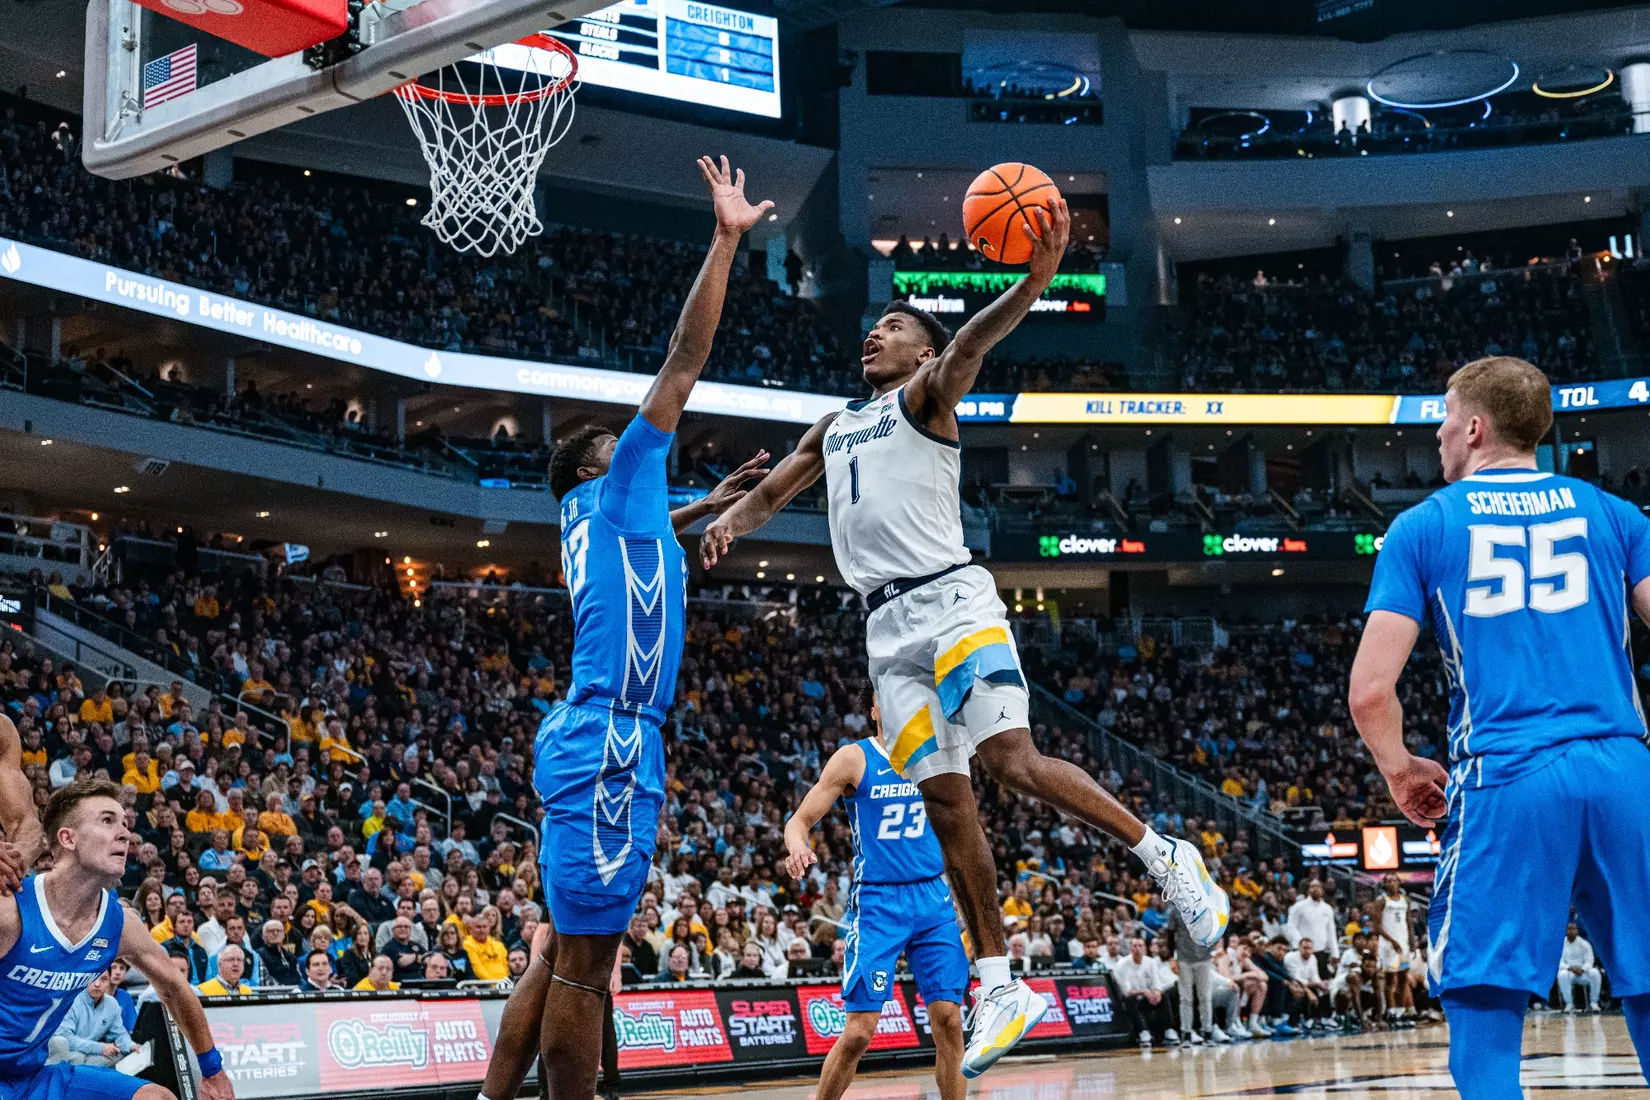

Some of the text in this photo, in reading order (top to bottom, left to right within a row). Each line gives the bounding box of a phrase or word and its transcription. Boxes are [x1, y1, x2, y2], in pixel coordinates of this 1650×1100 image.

[687, 5, 754, 31] CREIGHTON
[721, 68, 729, 82] 1
[105, 270, 363, 355] Pursuing Better Healthcare
[1559, 386, 1599, 407] TOL
[979, 401, 1004, 416] PM
[1086, 400, 1223, 415] KILL TRACKER: XX
[1420, 400, 1447, 419] FL
[824, 414, 897, 456] Marquette
[849, 456, 860, 504] 1
[1466, 488, 1576, 516] SCHEIERMAN
[1059, 535, 1116, 554] clover
[1223, 534, 1279, 552] clover
[1463, 517, 1589, 618] 55
[870, 783, 922, 799] CREIGH
[876, 801, 927, 840] 23
[731, 1000, 791, 1017] SUPER
[881, 999, 902, 1016] UTO
[1065, 997, 1112, 1015] START
[24, 998, 63, 1042] 1
[679, 1009, 713, 1027] AUTO
[728, 1015, 796, 1036] START
[209, 1023, 300, 1045] SUPER
[434, 1020, 477, 1041] AUTO
[614, 1010, 674, 1051] 'Reilly
[680, 1027, 723, 1047] PARTS
[329, 1020, 429, 1069] O'Reilly
[433, 1040, 487, 1063] PARTS
[225, 1065, 298, 1081] ATTERIES
